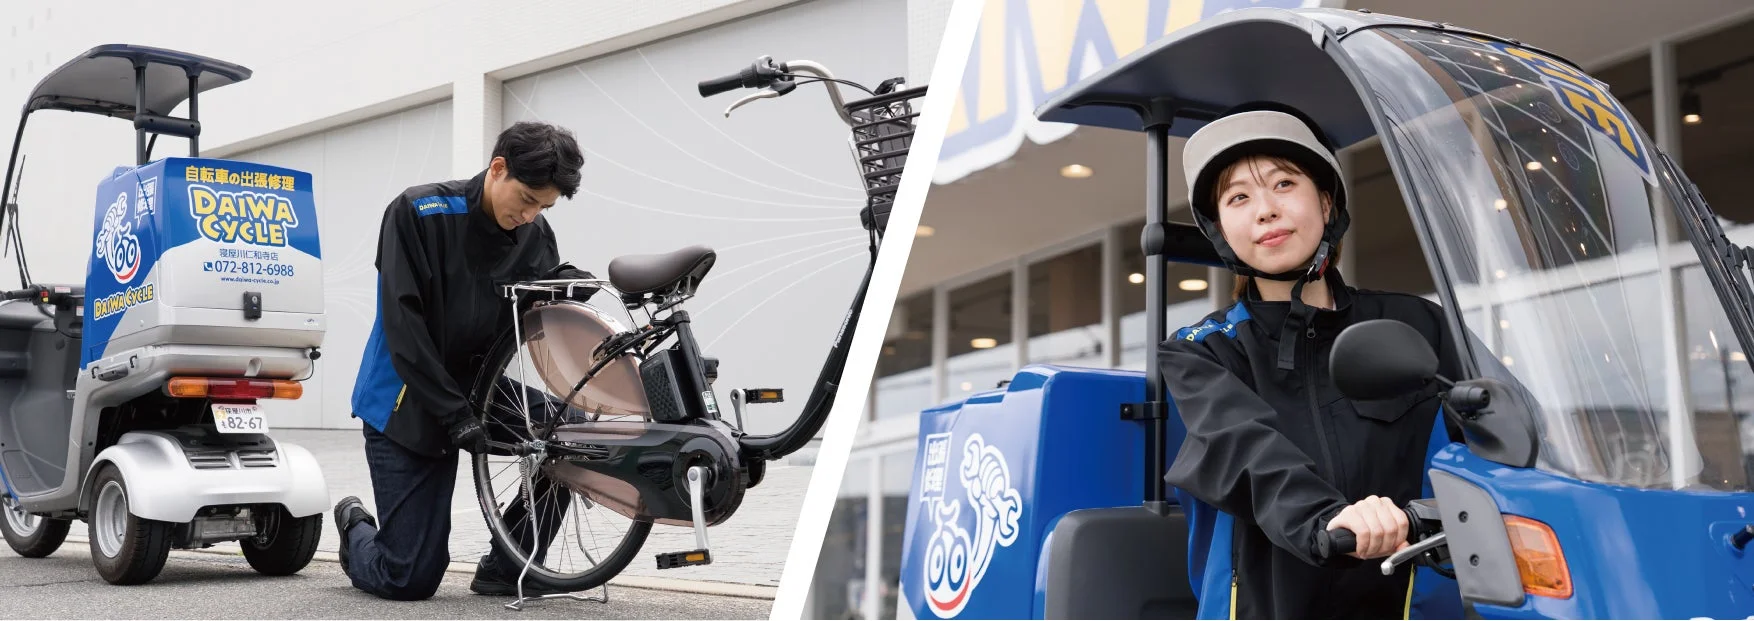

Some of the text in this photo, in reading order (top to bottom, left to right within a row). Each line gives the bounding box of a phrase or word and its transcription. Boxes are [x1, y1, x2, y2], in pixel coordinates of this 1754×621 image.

[185, 166, 295, 191] 自転車の出張修理
[192, 188, 295, 223] DAIWA
[202, 214, 284, 244] CYCLE
[219, 248, 279, 261] 寝屋川仁和寺店
[214, 260, 294, 277] 072-812-6988
[221, 276, 280, 285] www.daiwa-cycle.co.jp
[94, 283, 154, 319] DAIWA CYCLE
[228, 417, 262, 429] 82-67
